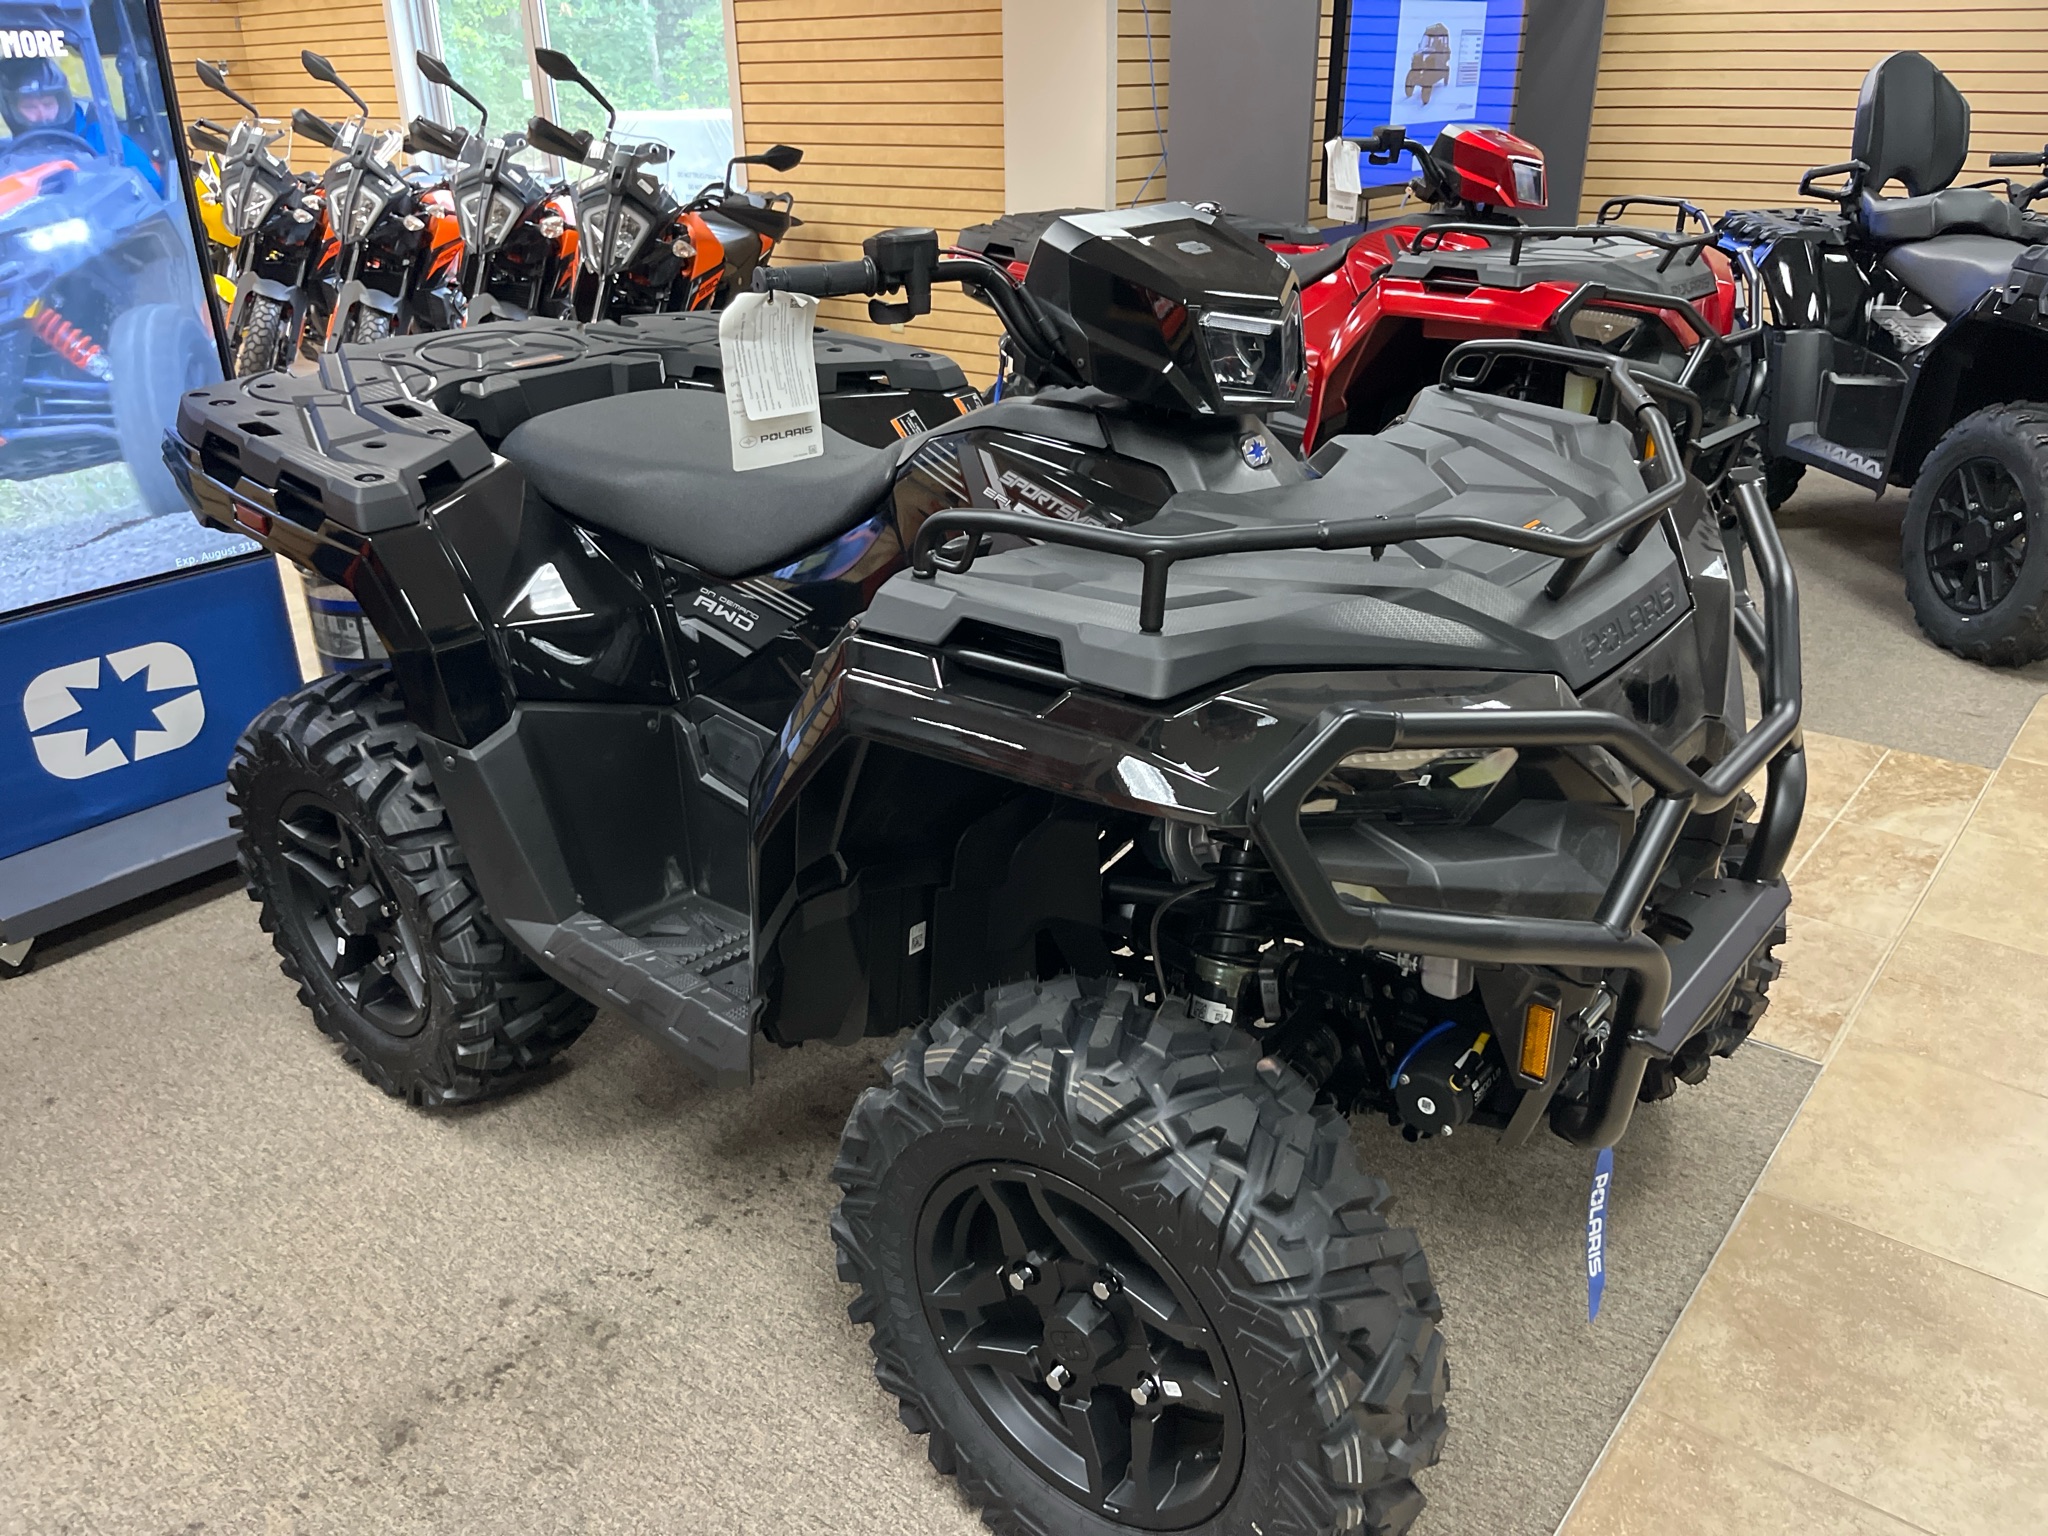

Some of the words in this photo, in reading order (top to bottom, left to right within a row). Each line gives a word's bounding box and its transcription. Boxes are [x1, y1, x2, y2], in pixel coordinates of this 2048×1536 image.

[0, 30, 69, 58] MORE
[760, 426, 814, 443] POLARIS
[983, 486, 1011, 507] EFI
[175, 556, 199, 567] Exp.
[201, 546, 237, 561] August
[693, 595, 755, 632] AWD
[1581, 583, 1676, 669] POLARIS
[1588, 1172, 1609, 1277] POLARIS
